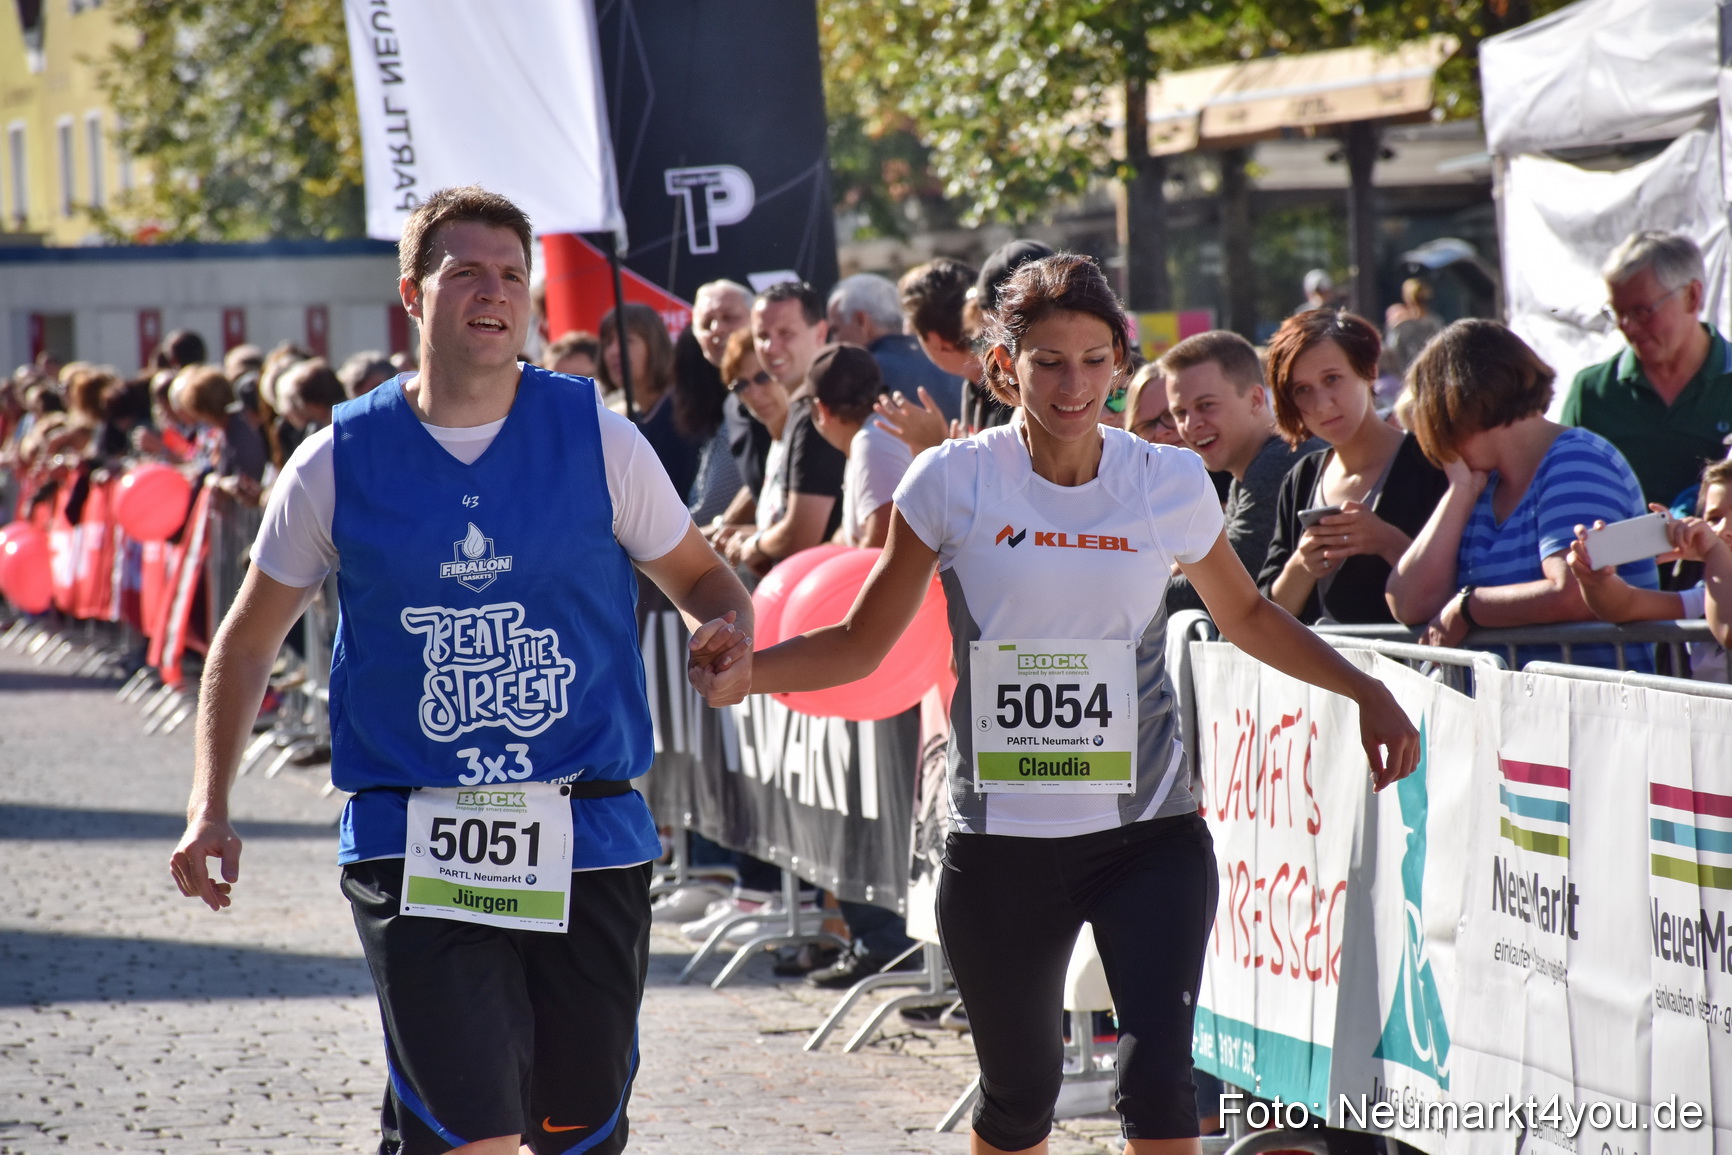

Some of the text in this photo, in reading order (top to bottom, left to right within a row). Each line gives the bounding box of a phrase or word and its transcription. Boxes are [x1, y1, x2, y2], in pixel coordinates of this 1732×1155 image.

[461, 495, 480, 509] 43
[1034, 532, 1138, 552] KLEBL
[442, 558, 511, 576] FIBALON
[462, 572, 492, 582] BASKETS
[406, 610, 552, 668] BEAT THE
[1017, 654, 1089, 670] BOCK
[423, 656, 567, 732] STREET
[996, 683, 1112, 729] 5054
[981, 720, 987, 728] S
[1007, 737, 1089, 745] PARTL Neumarkt
[456, 743, 534, 786] 3x3
[1018, 757, 1091, 776] Claudia
[456, 791, 527, 807] BOCK
[429, 817, 541, 867] 5051
[439, 867, 522, 884] PARTL Neumarkt
[452, 888, 519, 914] Jürgen
